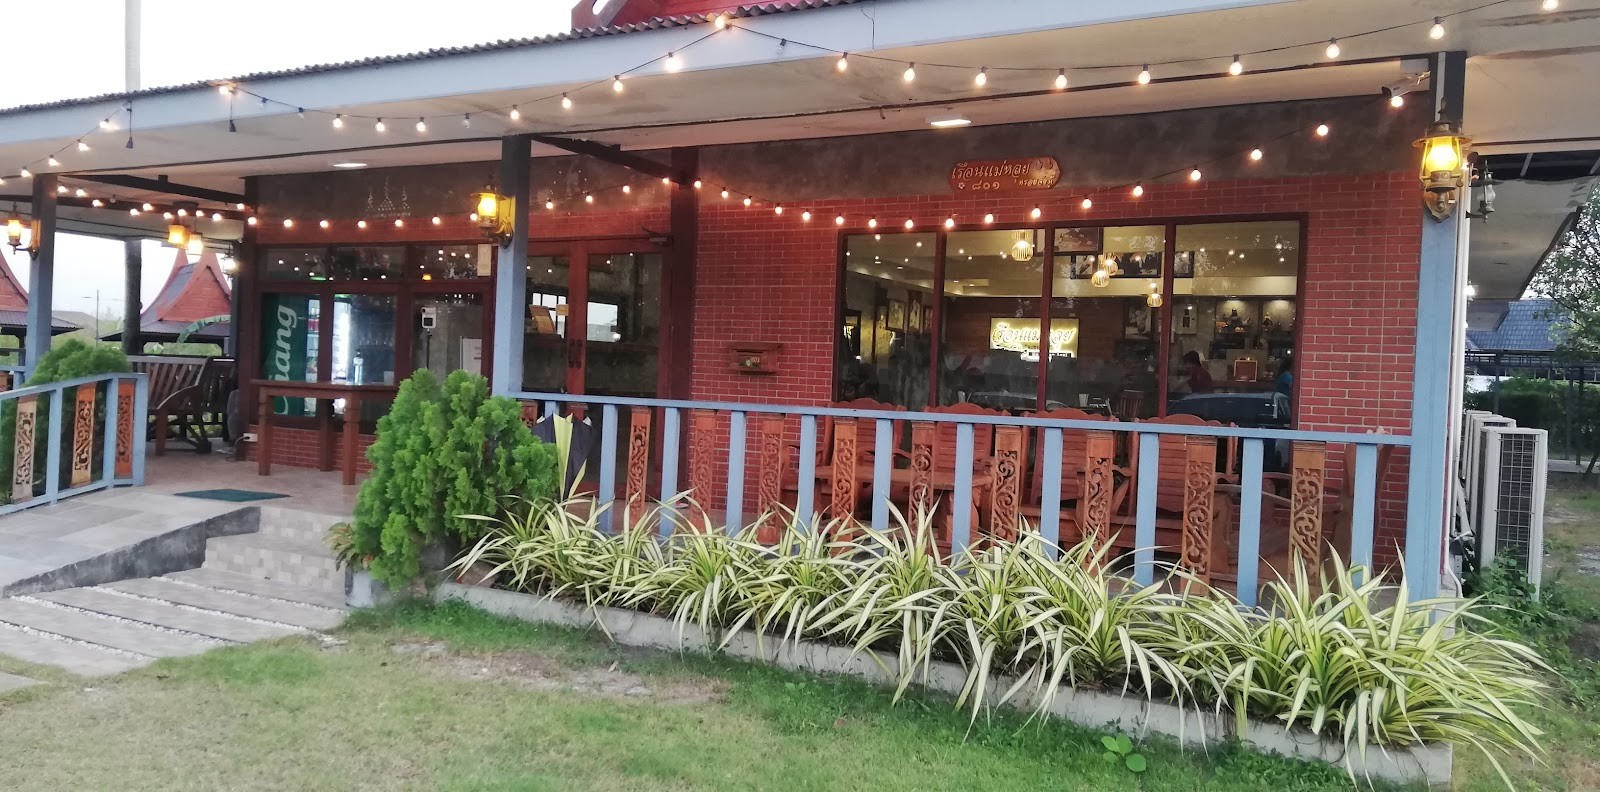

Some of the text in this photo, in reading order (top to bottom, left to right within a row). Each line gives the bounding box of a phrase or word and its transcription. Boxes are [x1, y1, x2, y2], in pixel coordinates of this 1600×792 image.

[951, 160, 1031, 180] เรือนแม่หอย
[972, 180, 1000, 190] ๘๐๑
